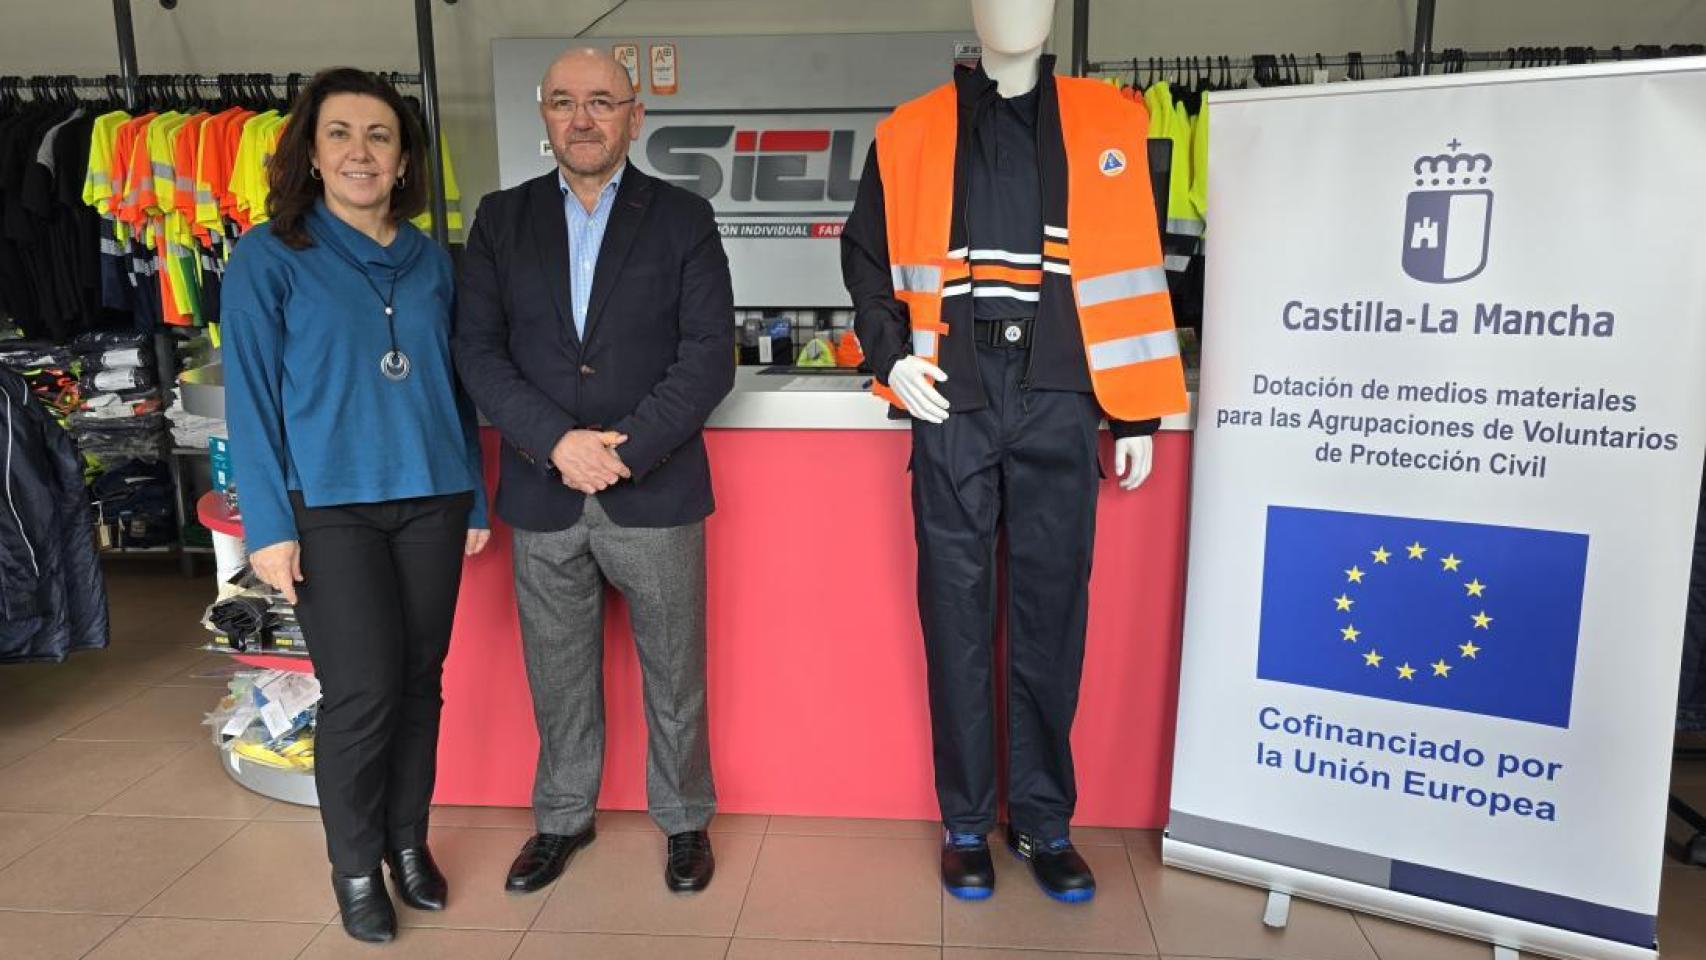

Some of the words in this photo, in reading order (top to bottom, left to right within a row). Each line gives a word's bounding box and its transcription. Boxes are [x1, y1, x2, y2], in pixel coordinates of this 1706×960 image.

[741, 225, 808, 235] INDIVIDUAL
[1283, 300, 1459, 334] Castilla-La
[1474, 302, 1615, 338] Mancha
[1253, 374, 1353, 399] Dotación
[1361, 378, 1390, 401] de
[1397, 381, 1488, 405] medios
[1497, 386, 1637, 413] materiales
[1216, 408, 1262, 429] para
[1270, 406, 1301, 429] las
[1308, 408, 1475, 438] Agrupaciones
[1483, 418, 1514, 441] de
[1523, 419, 1679, 451] Voluntarios
[1315, 441, 1343, 463] de
[1350, 444, 1481, 473] Protección
[1489, 452, 1547, 478] Civil
[1258, 706, 1485, 768] Cofinanciado
[1497, 753, 1563, 781] por
[1257, 742, 1282, 769] la
[1294, 748, 1390, 791] Unión
[1403, 770, 1556, 822] Europea
